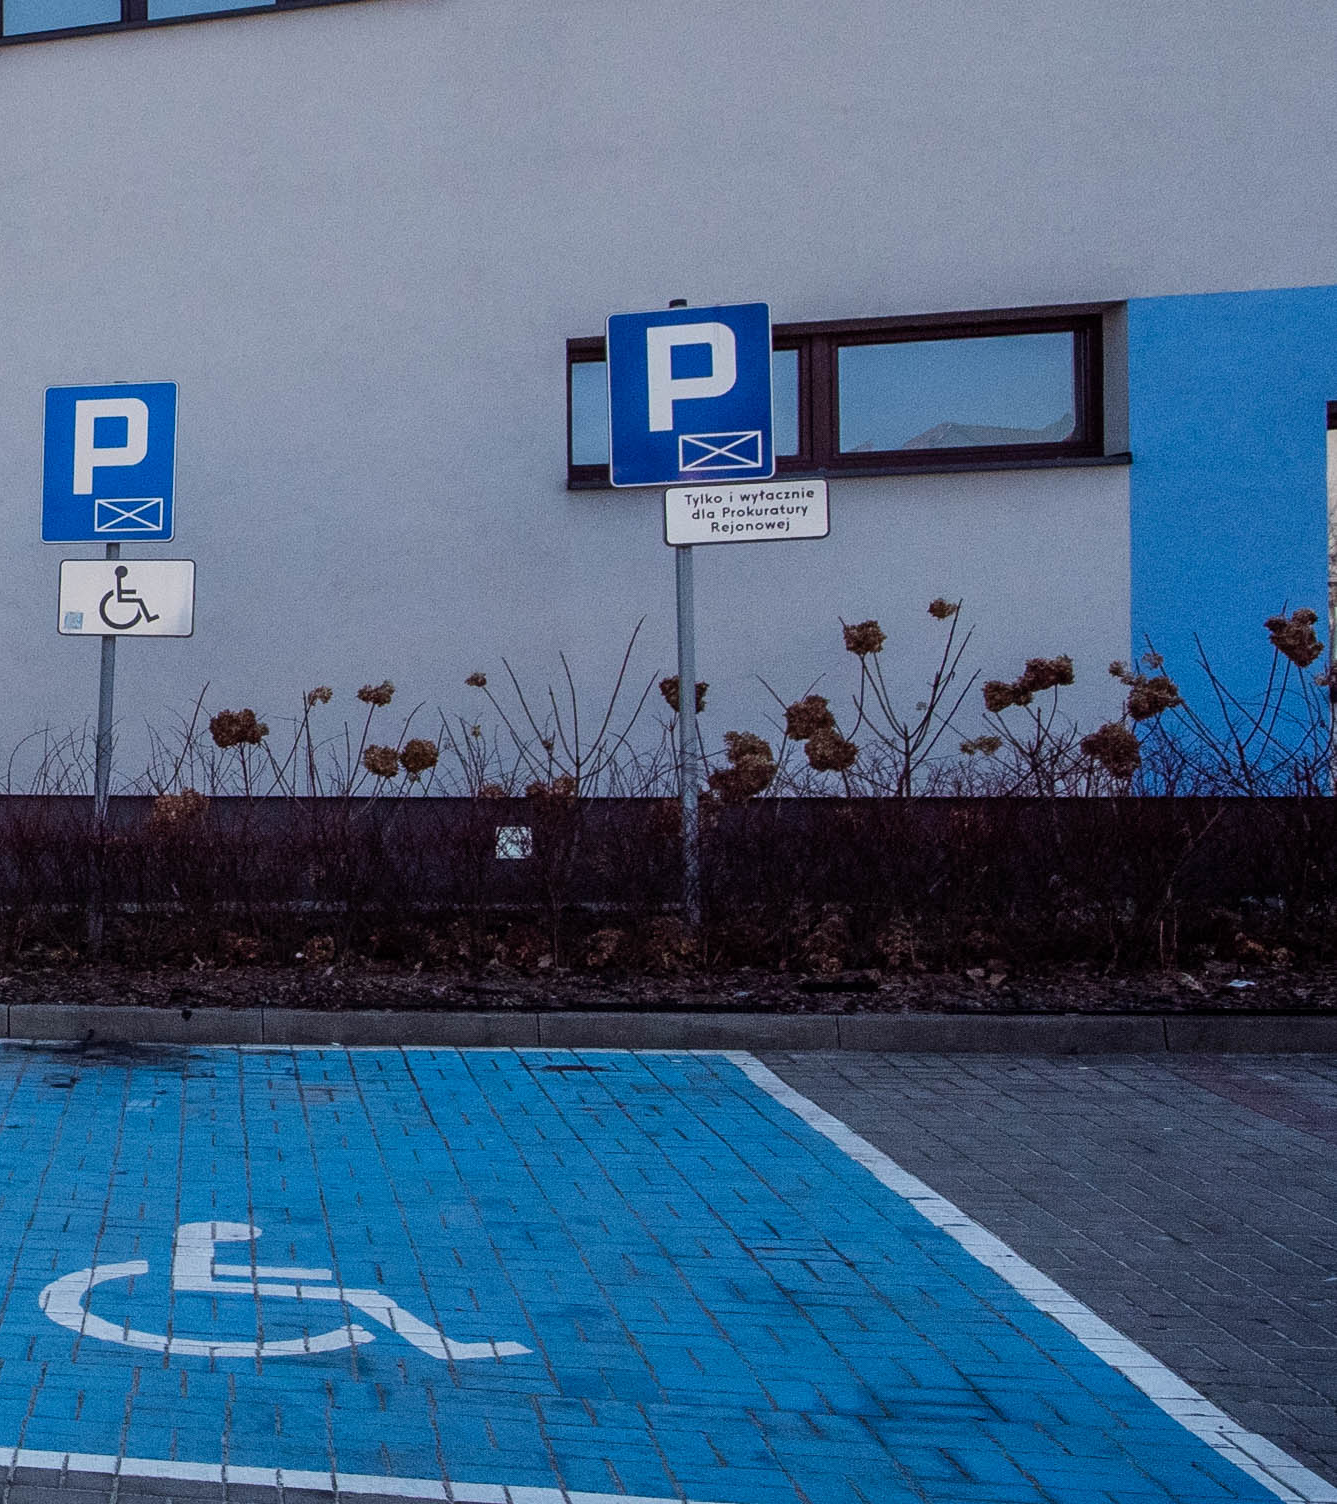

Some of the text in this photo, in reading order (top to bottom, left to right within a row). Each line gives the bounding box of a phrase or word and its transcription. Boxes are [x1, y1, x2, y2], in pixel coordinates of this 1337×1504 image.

[646, 322, 737, 432] P
[73, 397, 149, 495] P
[684, 494, 723, 508] Tylko
[729, 491, 734, 503] i
[691, 504, 808, 520] dla Prokuratury
[710, 518, 790, 535] Rejonowej
